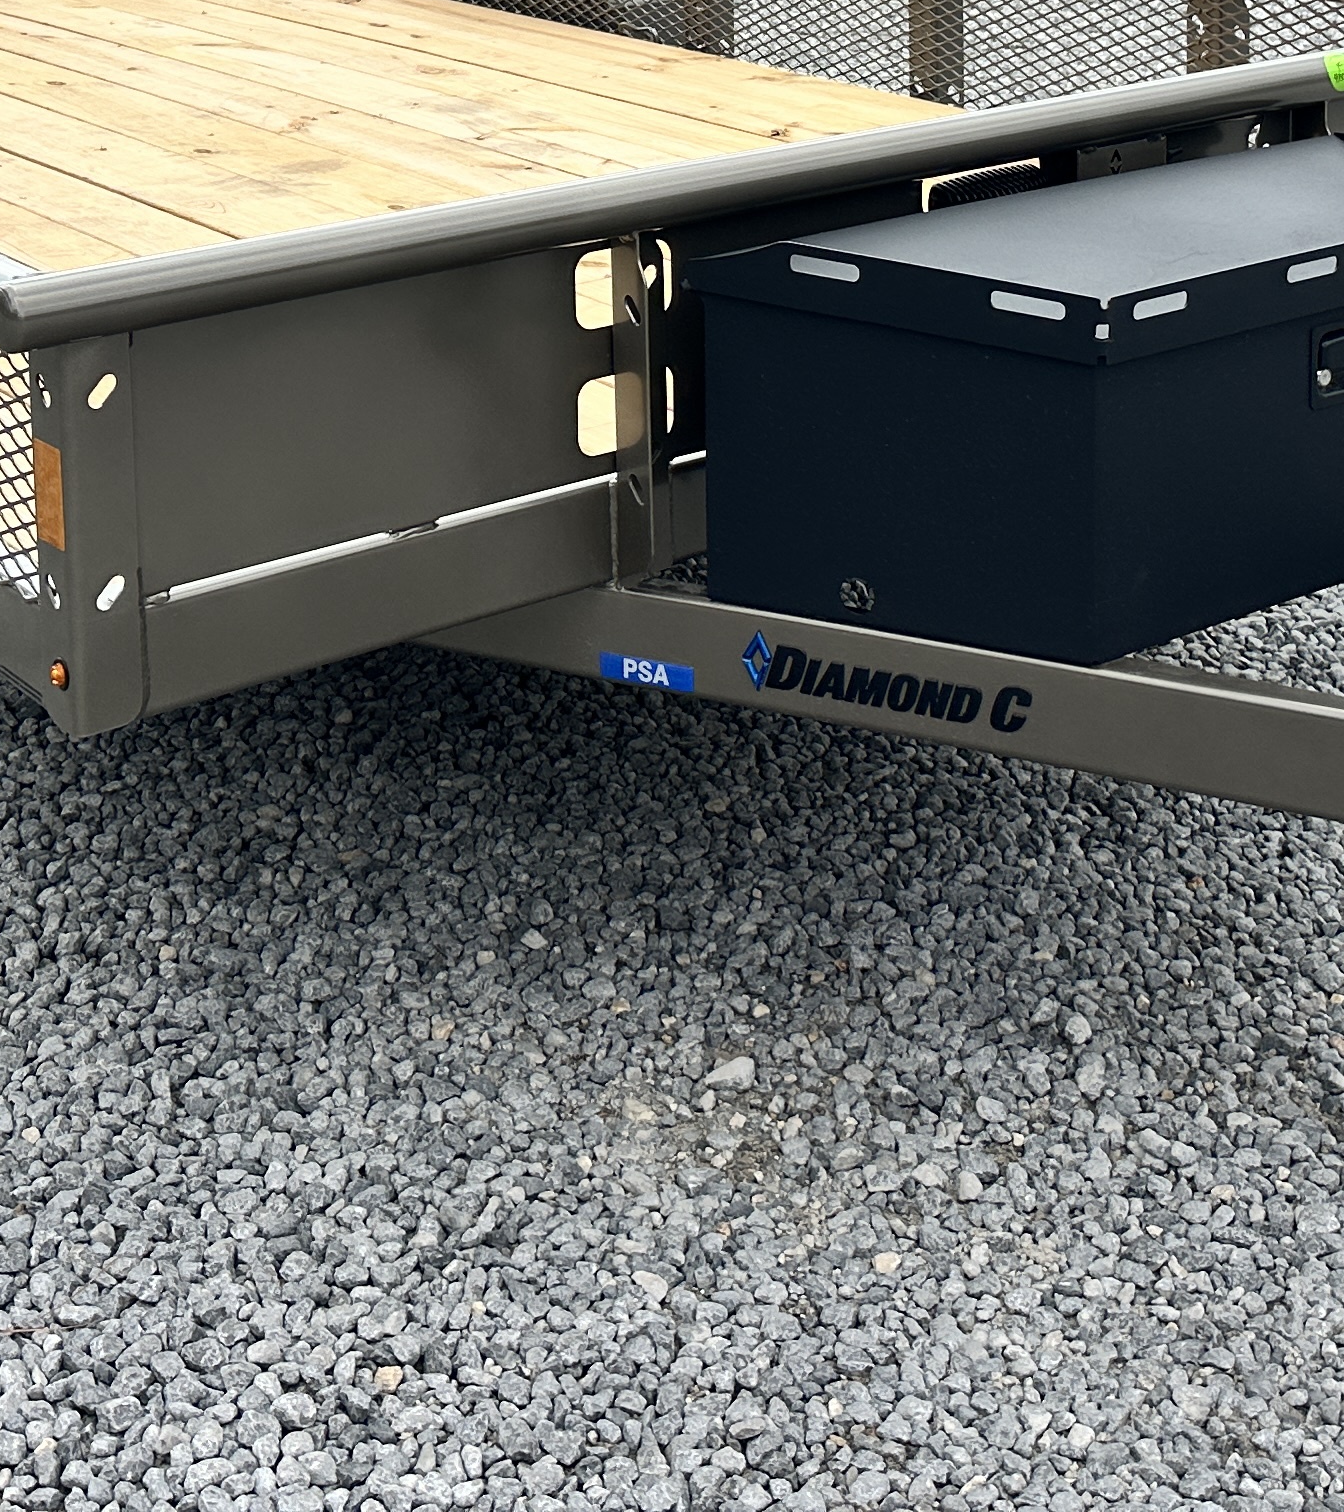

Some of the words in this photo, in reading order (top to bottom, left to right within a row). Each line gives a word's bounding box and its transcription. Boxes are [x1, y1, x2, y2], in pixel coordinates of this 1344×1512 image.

[623, 657, 670, 687] PSA
[765, 644, 983, 724] DIAMOND
[989, 685, 1033, 733] C
